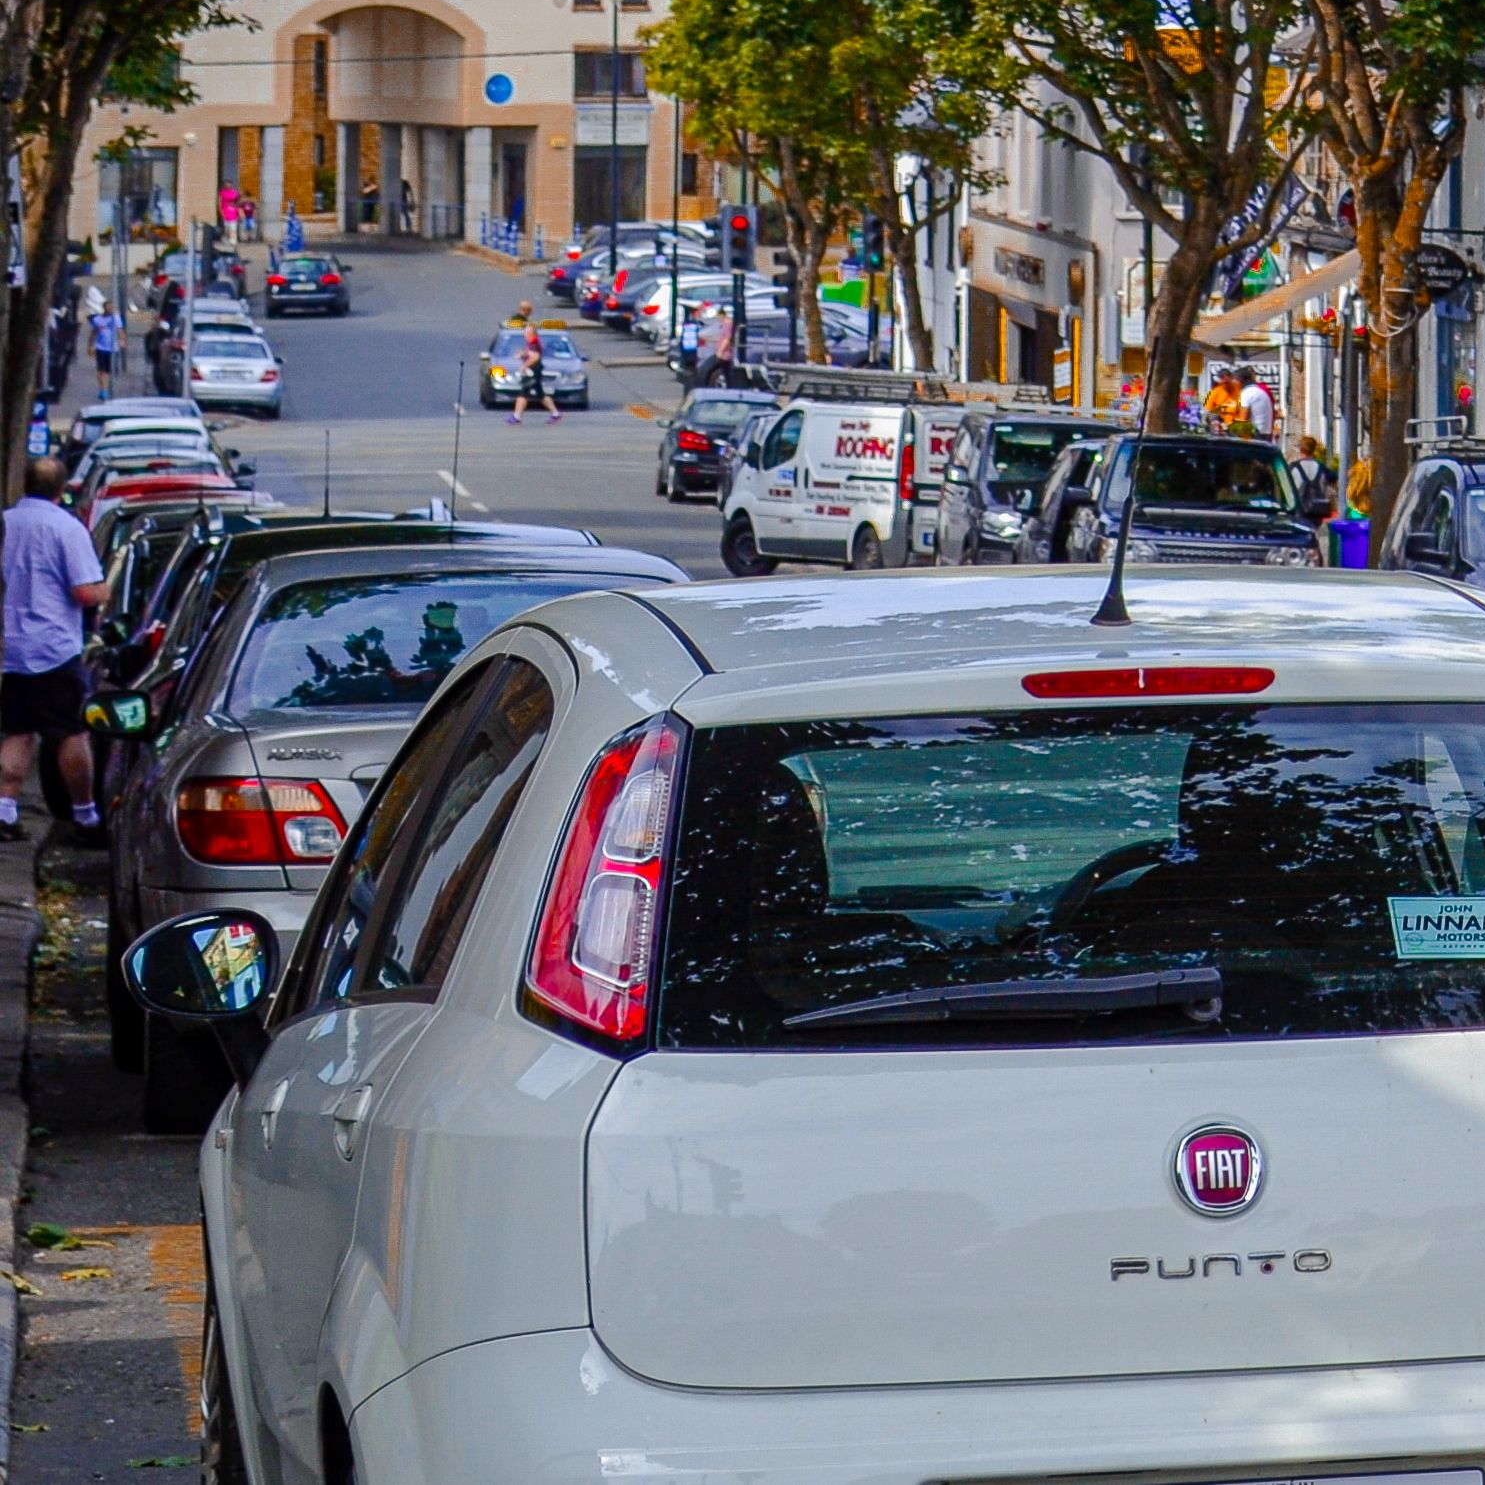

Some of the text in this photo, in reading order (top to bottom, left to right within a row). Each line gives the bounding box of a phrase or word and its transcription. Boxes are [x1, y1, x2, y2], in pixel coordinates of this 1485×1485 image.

[835, 435, 895, 461] ROOFING
[1439, 905, 1473, 914] JOHN
[1194, 1148, 1246, 1190] FIAT
[1110, 1247, 1333, 1282] PUNTO
